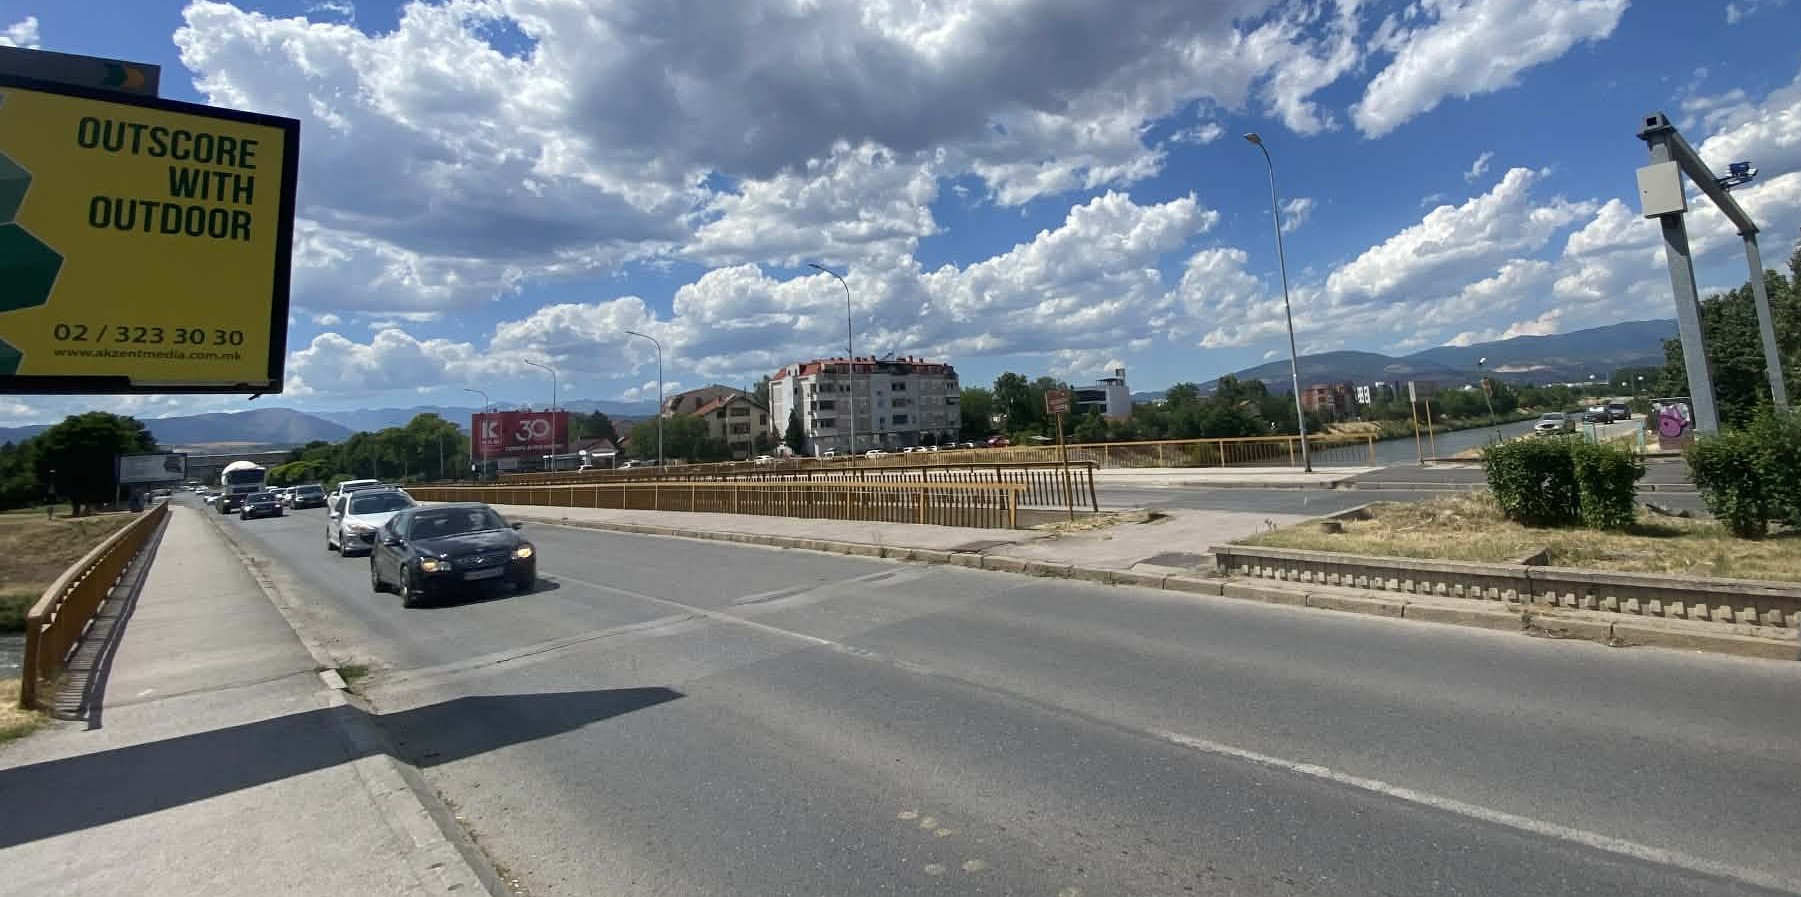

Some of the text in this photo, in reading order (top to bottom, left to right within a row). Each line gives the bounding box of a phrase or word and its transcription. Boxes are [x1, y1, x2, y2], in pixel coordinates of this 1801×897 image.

[77, 116, 259, 169] OUTSCORE
[168, 165, 254, 205] WITH
[88, 195, 251, 241] OUTDOOR
[54, 323, 244, 346] 02 / 323 30 30
[53, 347, 241, 361] www.akzentmedia.com.mk
[515, 418, 552, 442] 30
